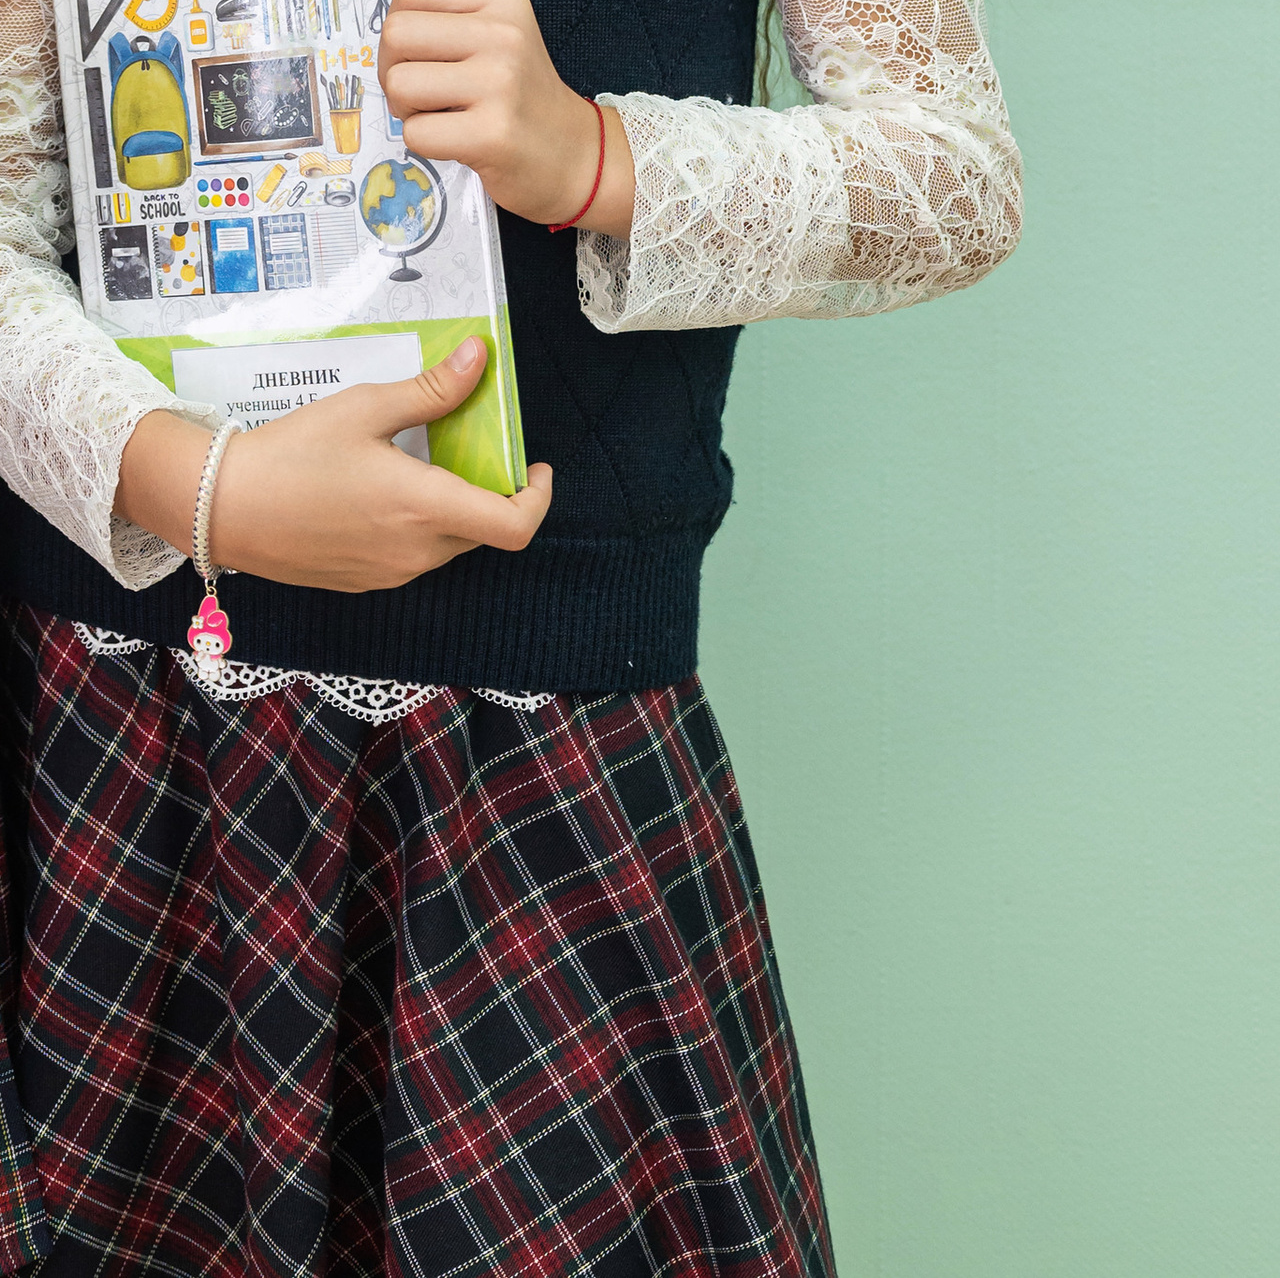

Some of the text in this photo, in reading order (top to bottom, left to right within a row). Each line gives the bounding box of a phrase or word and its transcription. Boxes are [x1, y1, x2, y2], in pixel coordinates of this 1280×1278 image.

[320, 45, 375, 72] 1+1=2
[143, 194, 166, 202] BACK
[140, 201, 186, 220] SCHOOL
[252, 368, 341, 390] ДНЕВНИК
[226, 398, 291, 417] ученицы
[295, 394, 304, 407] 4
